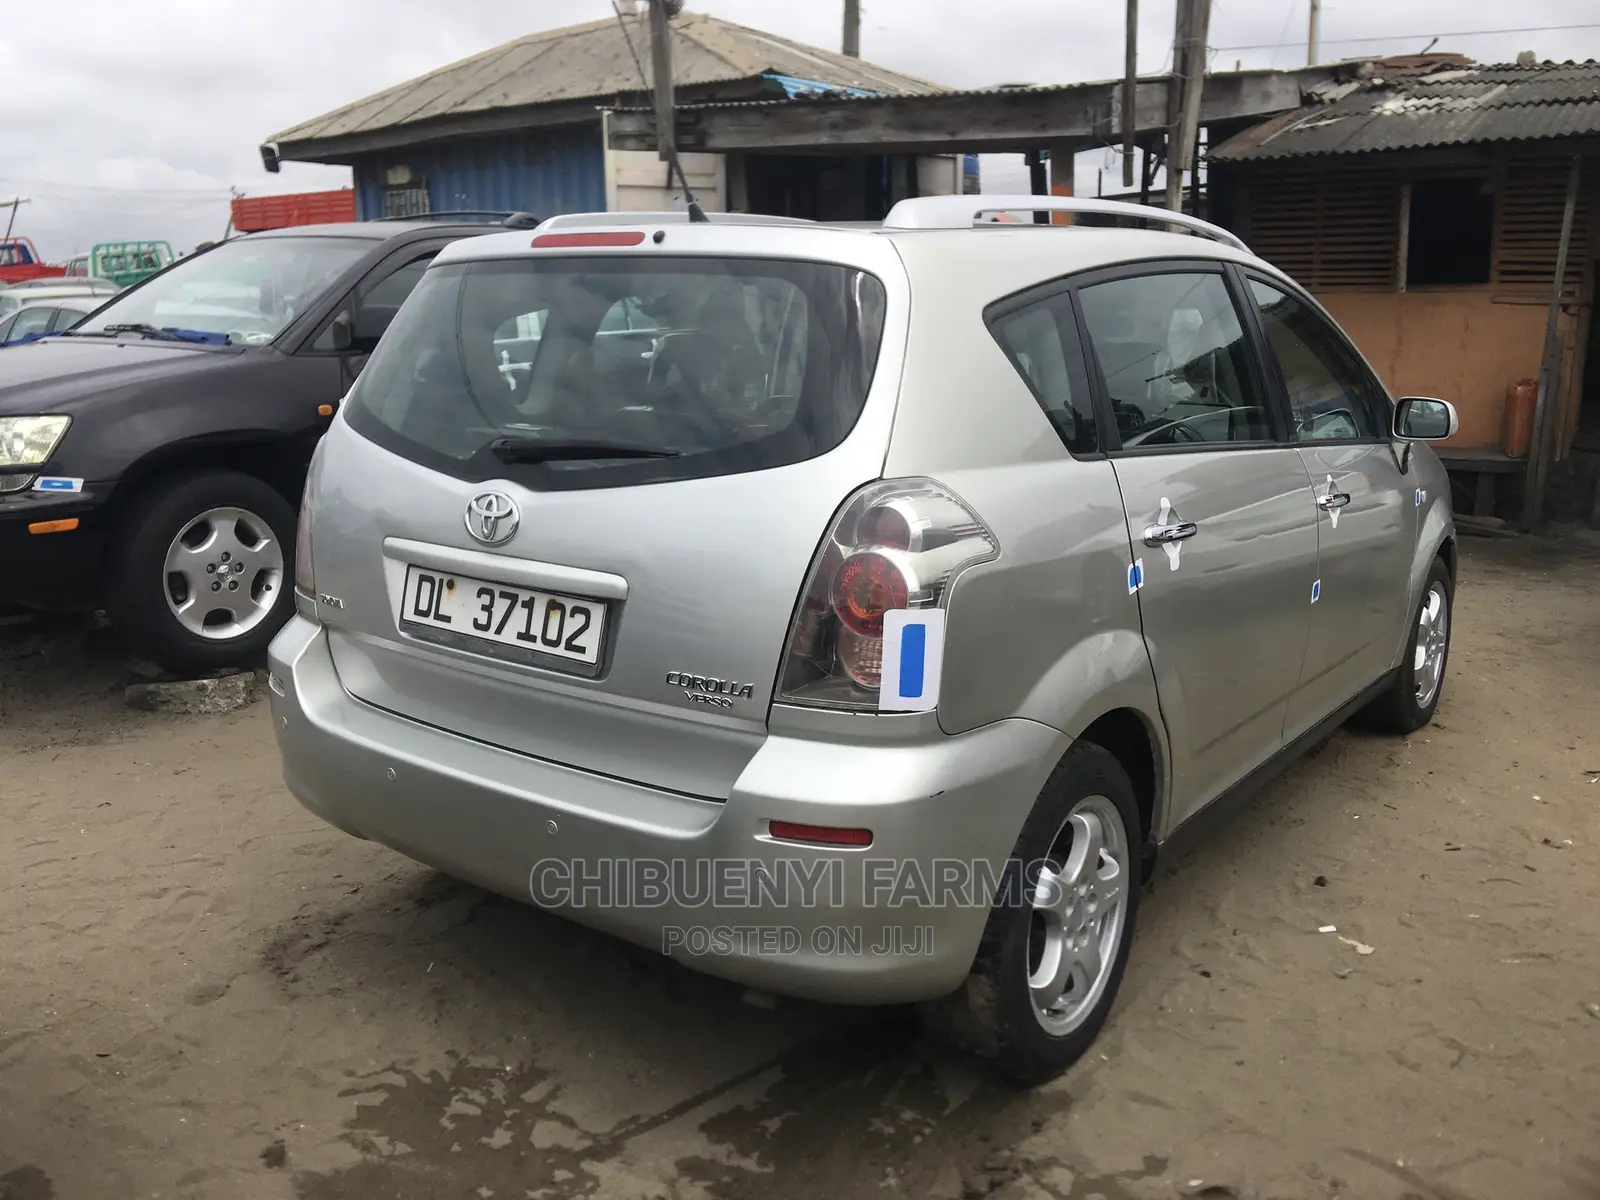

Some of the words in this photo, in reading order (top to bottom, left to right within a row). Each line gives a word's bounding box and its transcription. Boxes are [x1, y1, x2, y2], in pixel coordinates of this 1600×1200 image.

[414, 574, 452, 624] DL
[473, 586, 591, 655] 37102
[665, 671, 754, 700] COROLLA
[684, 690, 733, 709] VERSO
